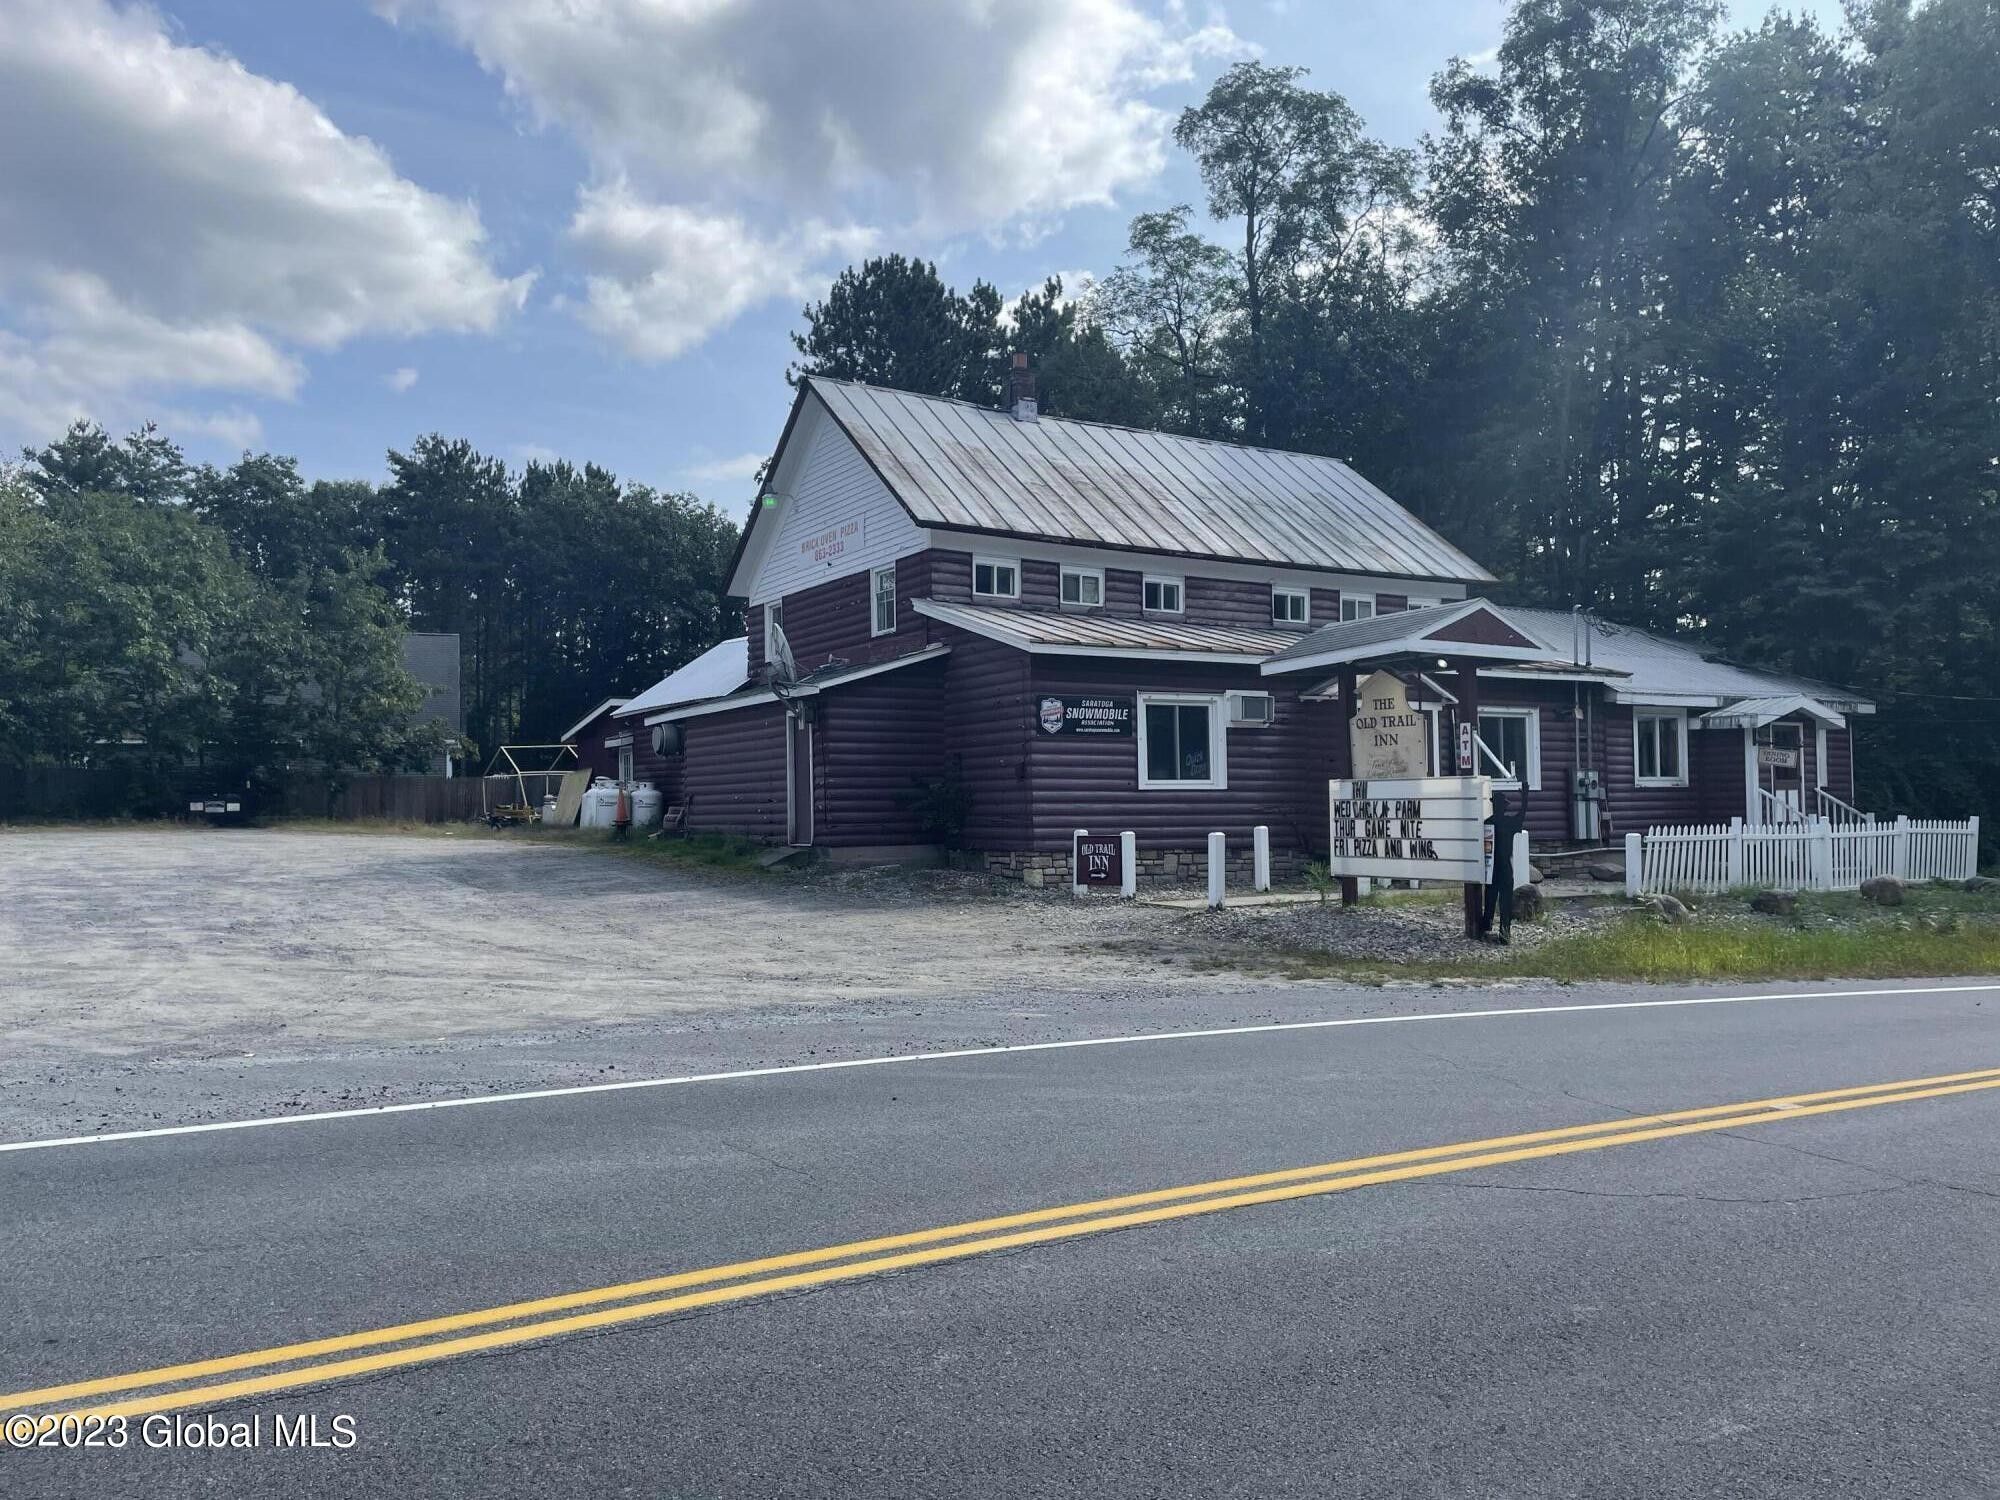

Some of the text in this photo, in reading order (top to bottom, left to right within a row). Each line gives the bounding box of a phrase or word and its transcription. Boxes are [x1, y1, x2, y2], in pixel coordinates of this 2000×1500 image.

[820, 530, 836, 546] OVEN
[840, 521, 859, 538] PIZZA
[1081, 699, 1114, 707] SARATOGA
[1372, 697, 1395, 710] THE
[1065, 707, 1129, 720] SNOWMOBILE
[1355, 714, 1417, 729] OLD TRAIL
[1373, 733, 1399, 747] INN
[1461, 726, 1471, 766] ATM
[1334, 800, 1351, 818] WED
[1395, 800, 1421, 819] PARM
[1334, 819, 1423, 838] THUR GAME NITE
[1081, 843, 1116, 856] OLD TRAIL
[1334, 839, 1348, 857] FRI
[1354, 839, 1378, 858] PIZZA
[1385, 840, 1403, 858] AND
[1088, 855, 1109, 872] INN
